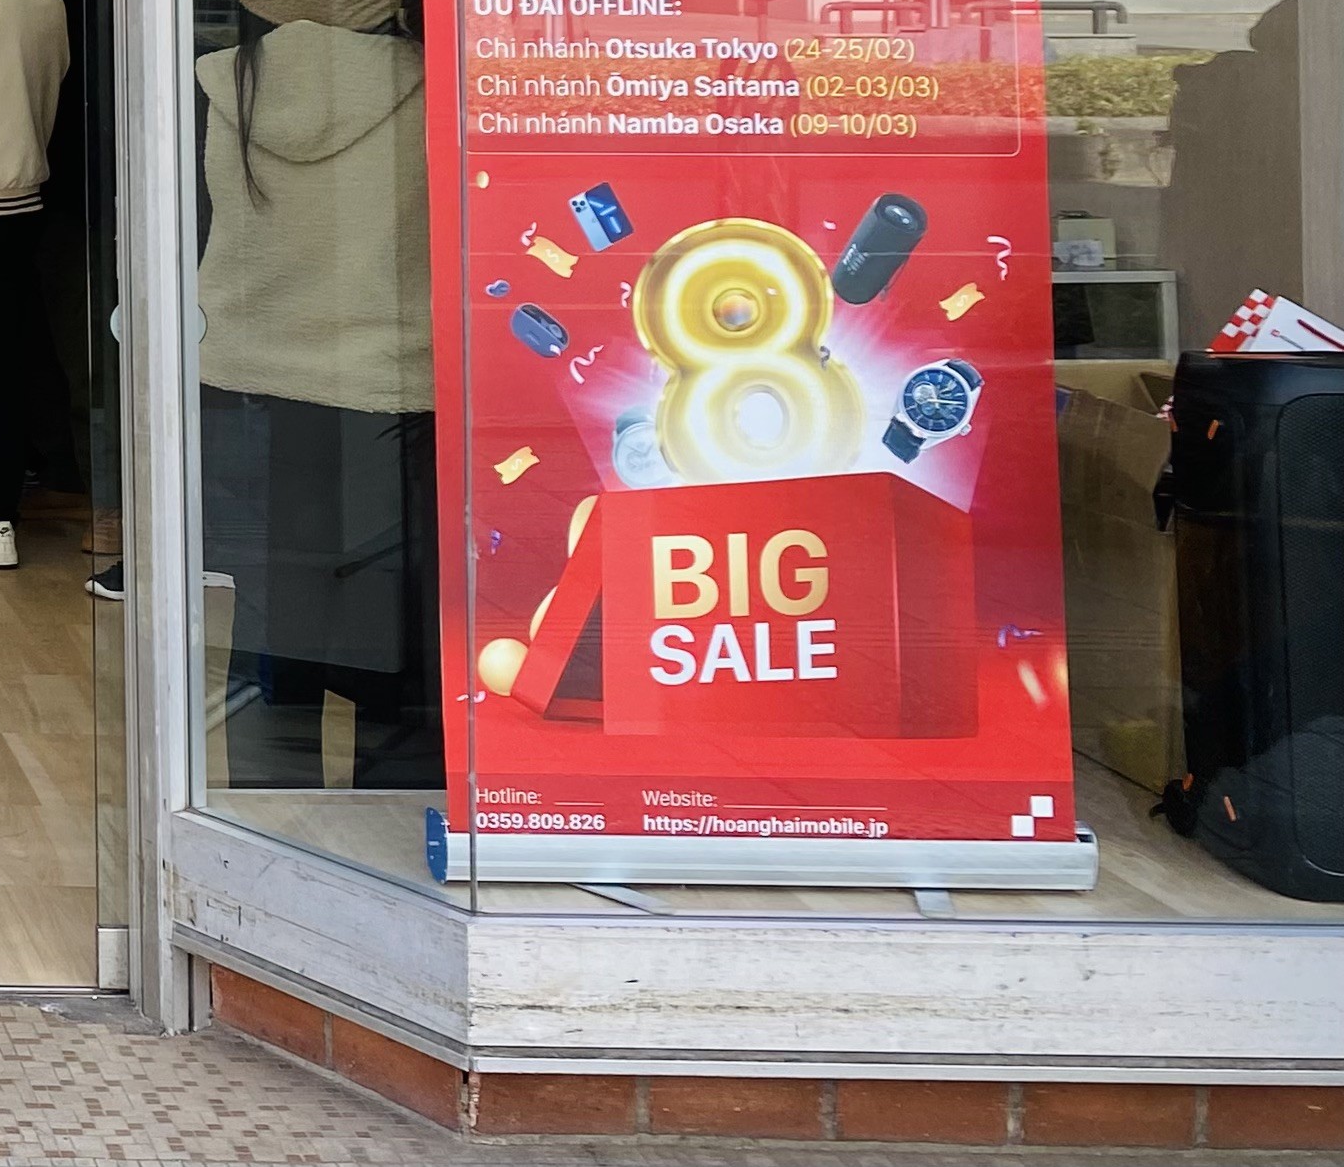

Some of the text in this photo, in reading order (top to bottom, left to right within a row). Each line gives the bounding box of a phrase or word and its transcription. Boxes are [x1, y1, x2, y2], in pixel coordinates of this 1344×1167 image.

[476, 36, 916, 65] Chi nhánh Otsuka Tokyo (24-25/02)
[477, 73, 941, 102] Chi nhánh Ōmiya Saitama (02-03/03)
[478, 110, 918, 138] Chi nhánh Namba Osaka (09-10/03)
[652, 528, 830, 620] BIG
[649, 618, 838, 686] SALE
[475, 787, 542, 806] Hotline:
[642, 790, 718, 810] Website:
[475, 812, 606, 832] 0359.809.826
[643, 814, 890, 838] https://hoanghaimobile.jp
